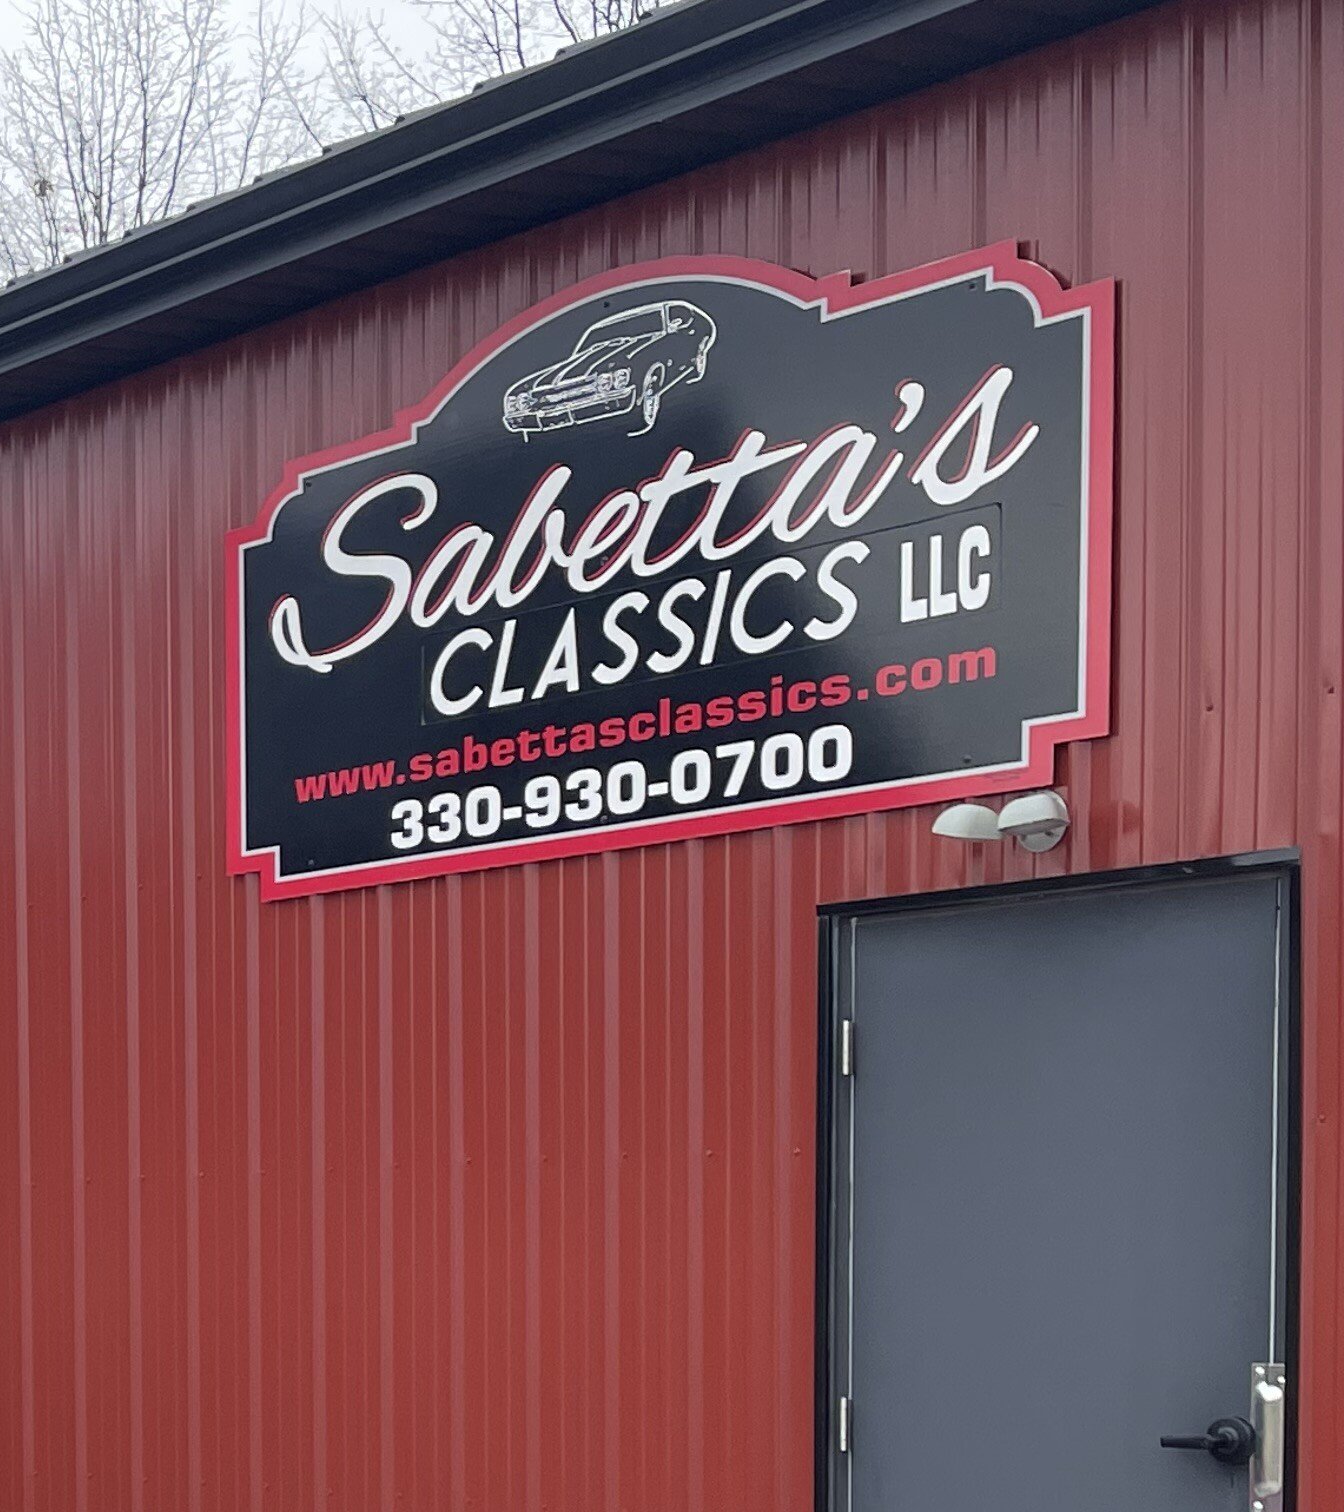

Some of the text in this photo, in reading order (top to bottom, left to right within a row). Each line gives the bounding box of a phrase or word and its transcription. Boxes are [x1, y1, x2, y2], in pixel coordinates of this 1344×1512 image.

[270, 364, 1040, 674] Sabetta's
[428, 524, 993, 717] CLASSICS LLC
[293, 645, 998, 804] www.sabettasclassics.com
[389, 724, 855, 851] 330-930-0700
